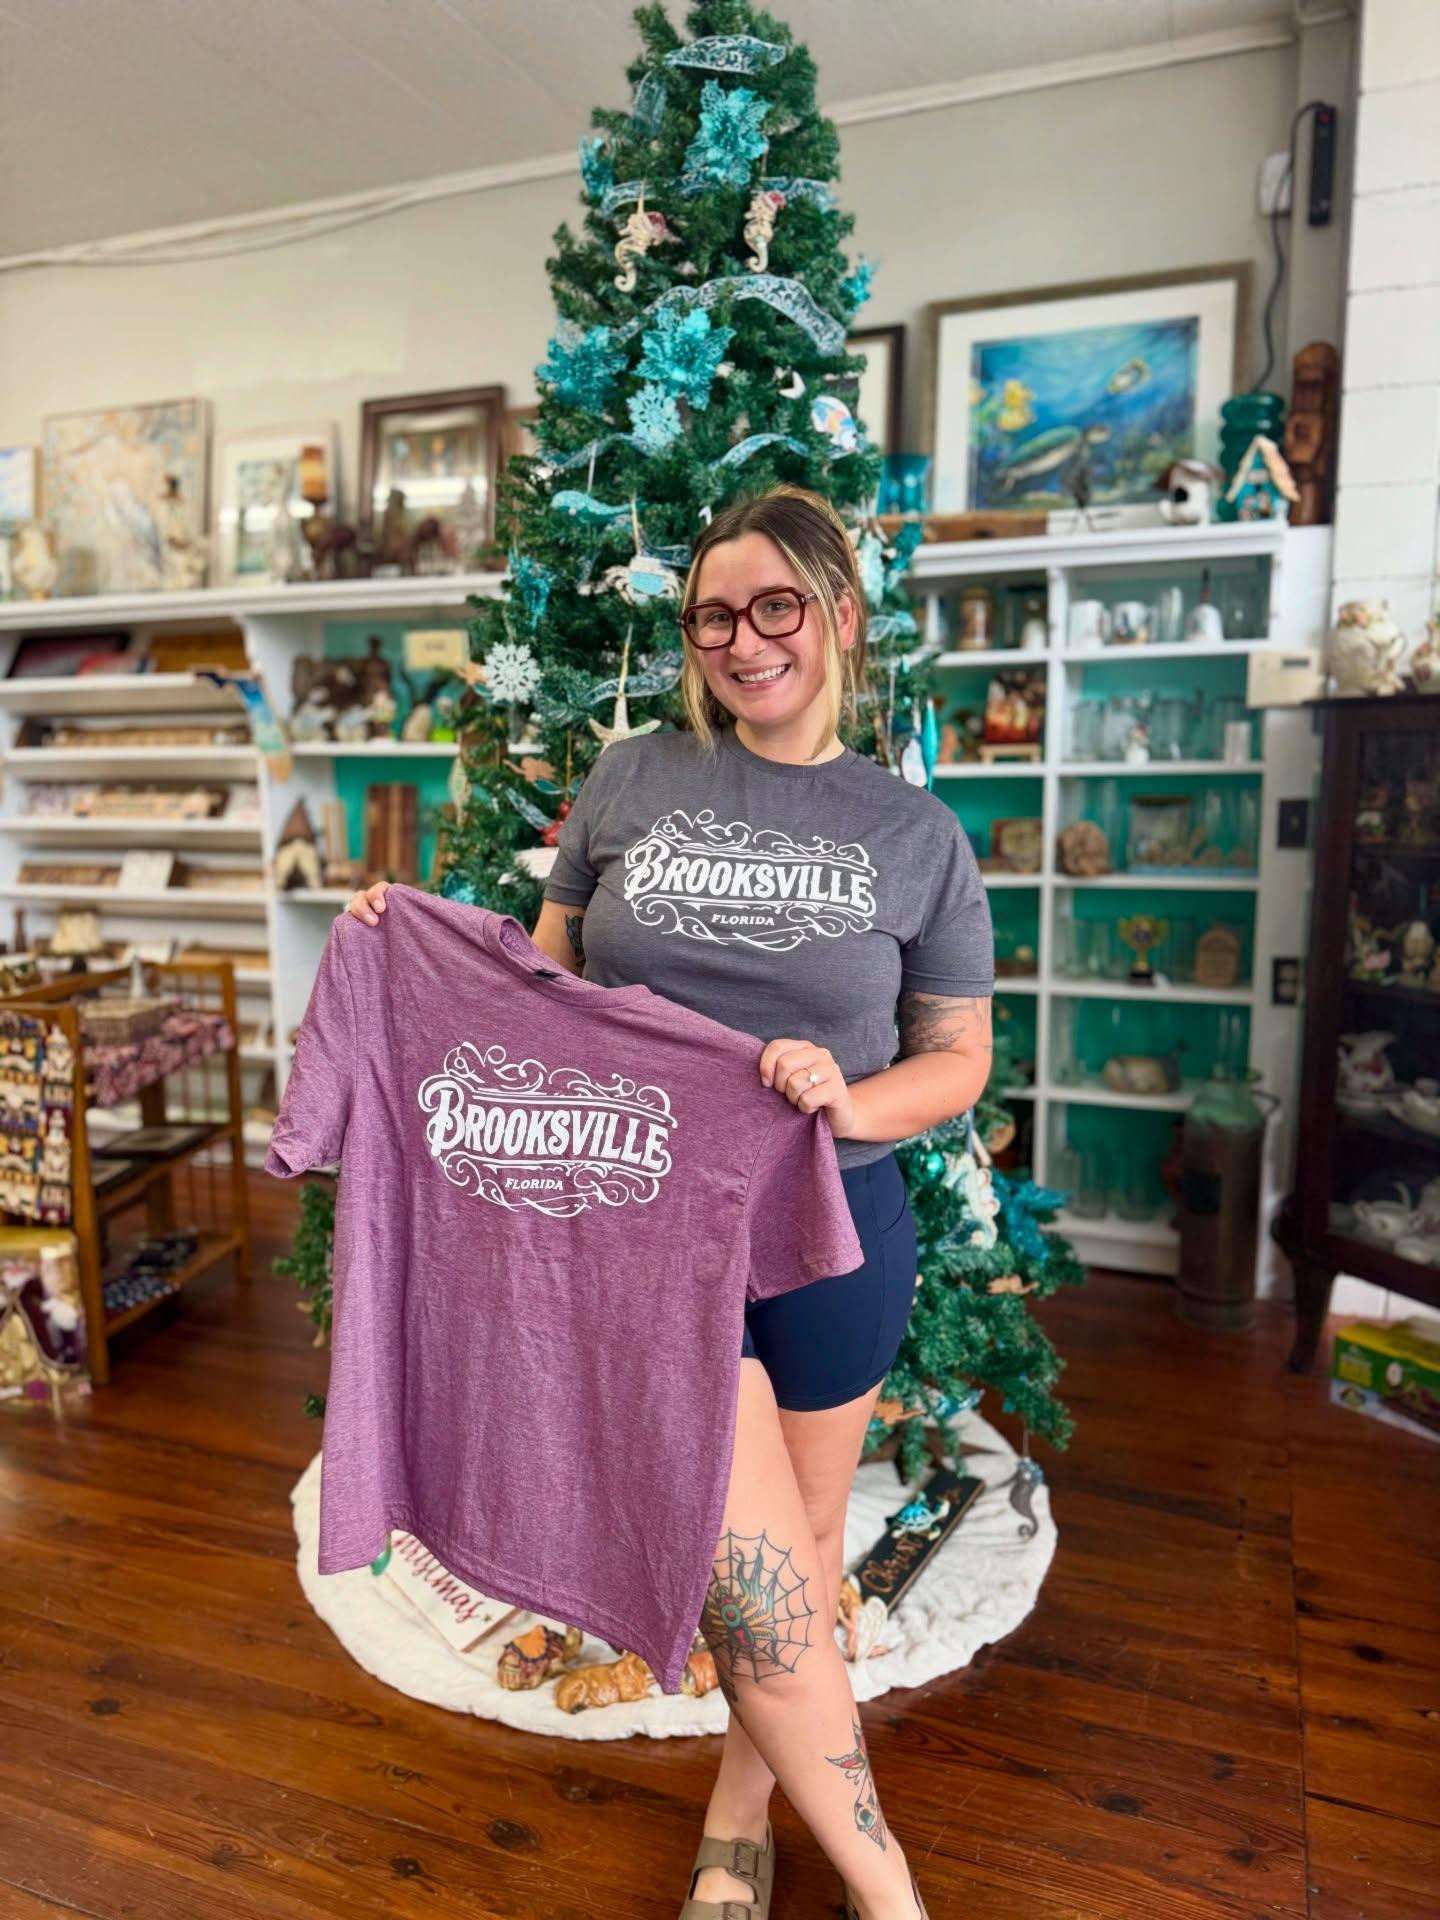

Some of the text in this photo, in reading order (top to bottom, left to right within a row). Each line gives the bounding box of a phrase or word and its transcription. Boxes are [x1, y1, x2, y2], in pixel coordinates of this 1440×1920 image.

[624, 837, 873, 911] BROOKSVILLE
[711, 913, 775, 926] FLORIDA
[420, 1079, 671, 1171] BROOKSVILLE
[504, 1177, 564, 1191] FLORIDA
